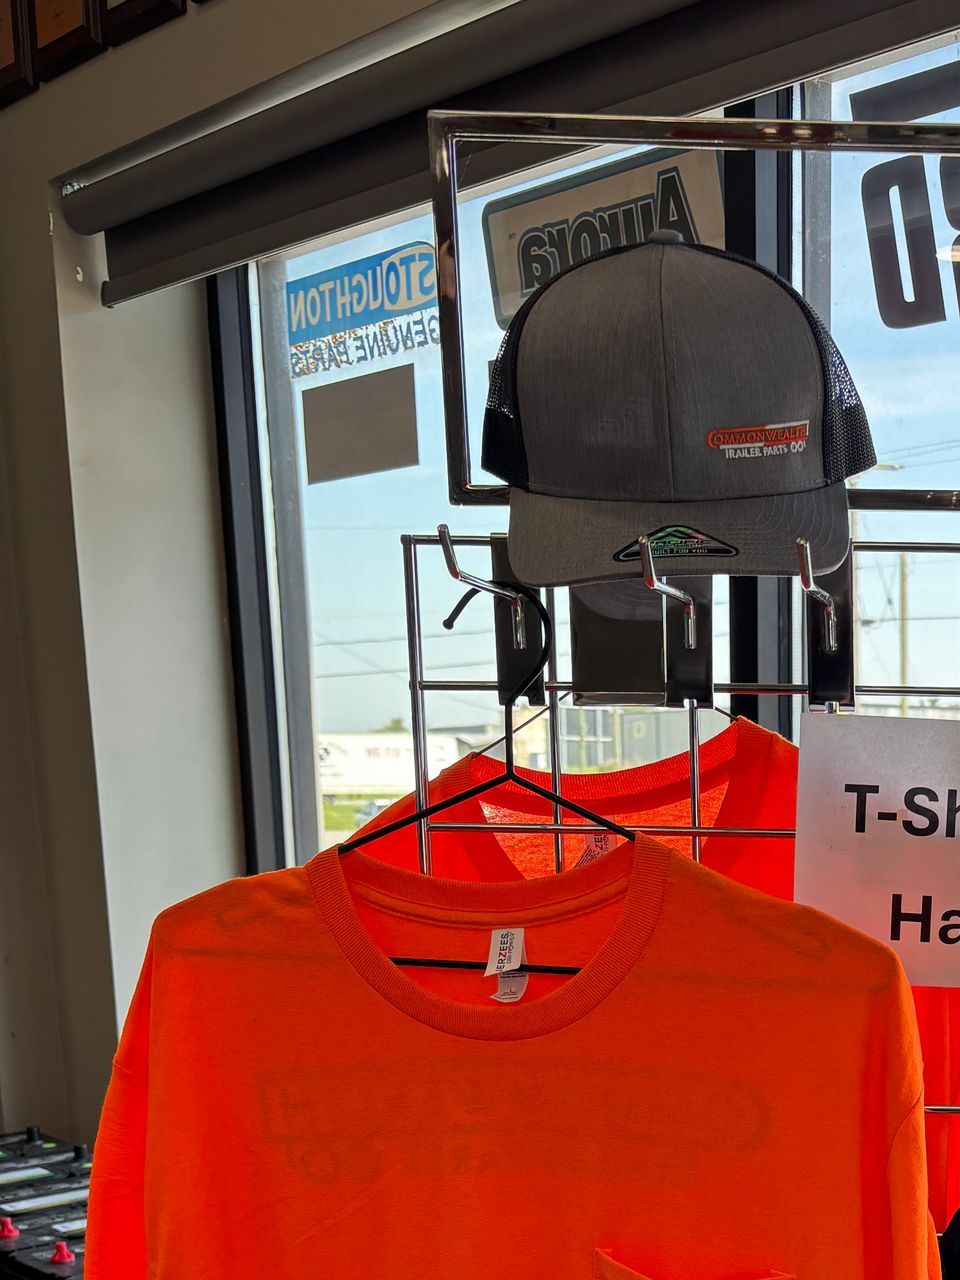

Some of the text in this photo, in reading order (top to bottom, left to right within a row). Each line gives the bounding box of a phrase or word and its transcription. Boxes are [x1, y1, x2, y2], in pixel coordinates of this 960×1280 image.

[706, 424, 806, 450] COMMONWEALTH
[725, 444, 788, 459] TRAILER PARTS
